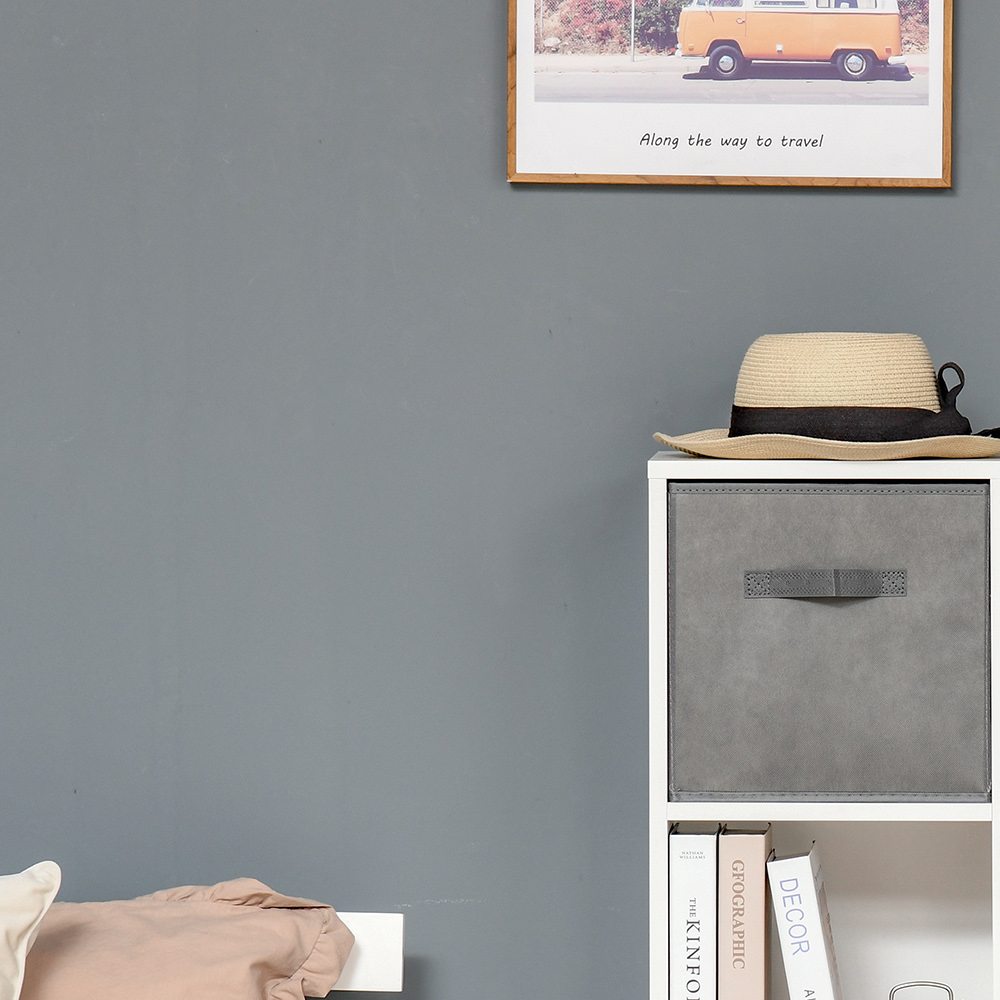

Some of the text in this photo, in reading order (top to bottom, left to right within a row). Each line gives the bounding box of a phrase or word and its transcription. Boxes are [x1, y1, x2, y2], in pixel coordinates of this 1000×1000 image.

[639, 133, 824, 150] Along the way to travel
[689, 897, 697, 918] THE
[780, 878, 811, 956] DECOR
